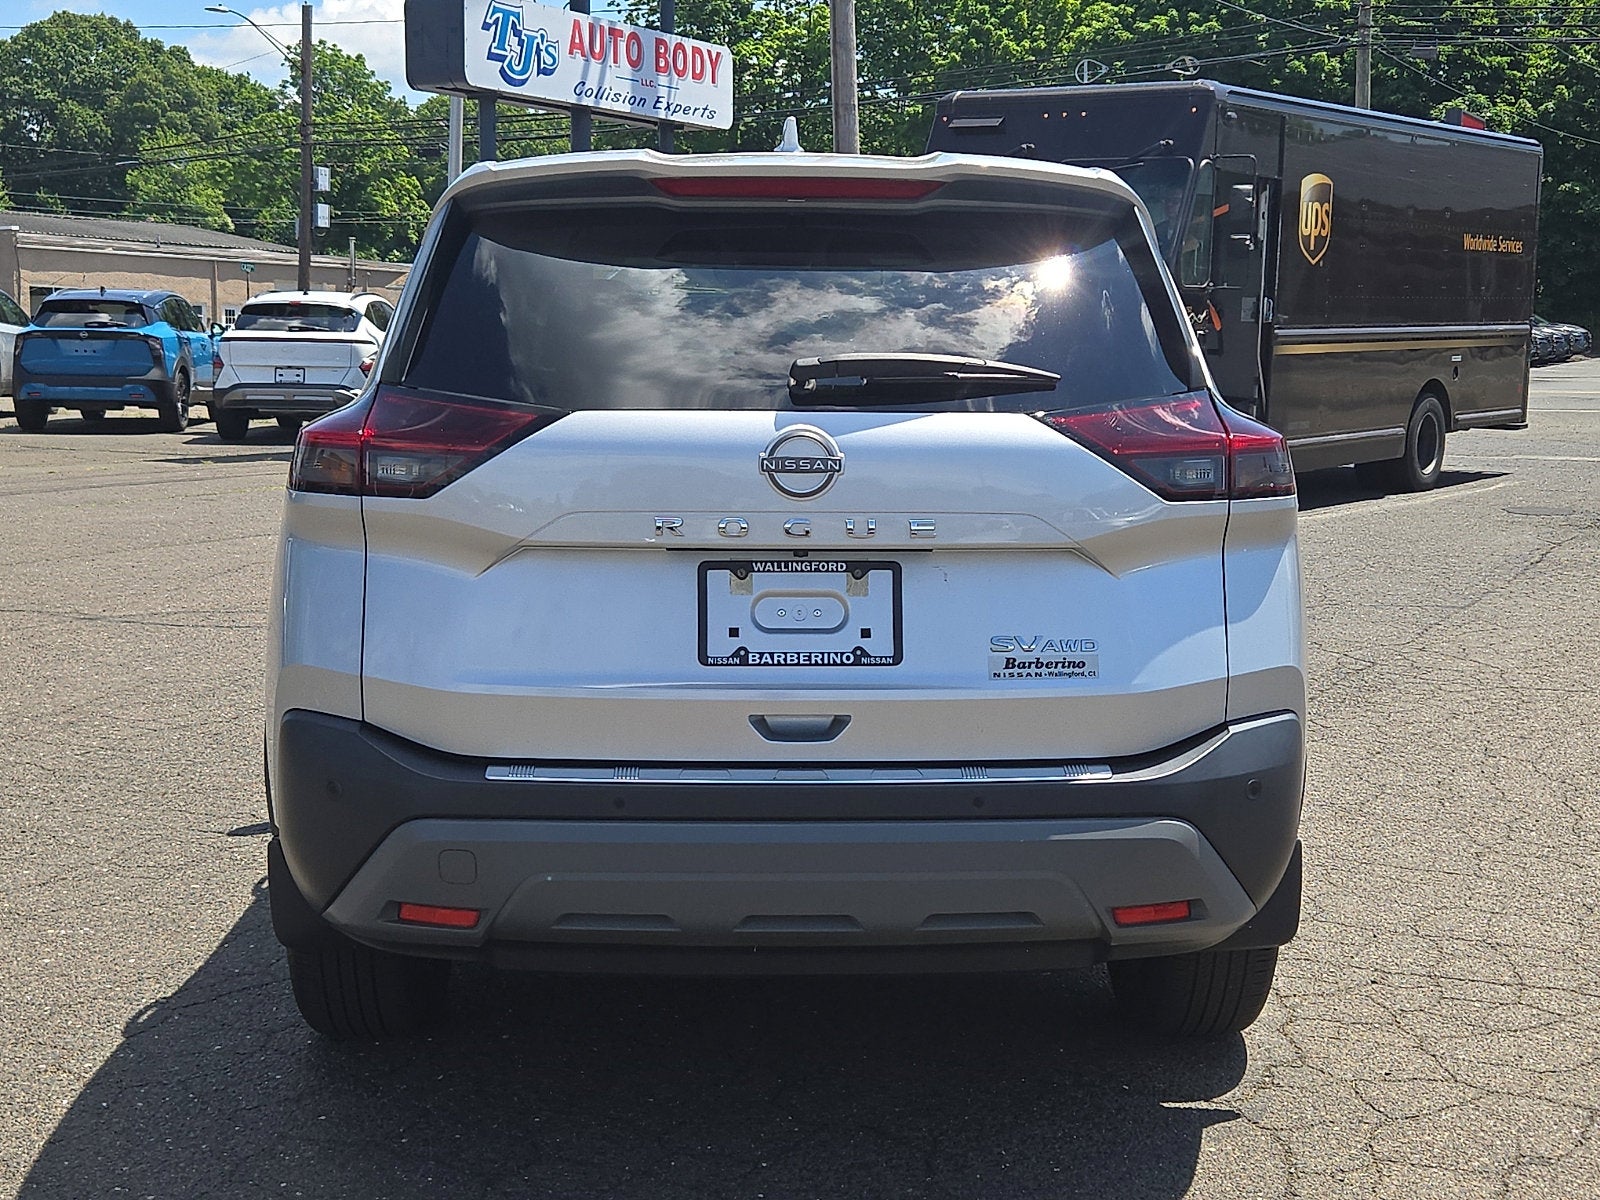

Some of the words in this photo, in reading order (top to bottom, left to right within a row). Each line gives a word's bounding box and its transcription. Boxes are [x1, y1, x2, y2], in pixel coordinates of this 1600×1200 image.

[482, 0, 560, 87] TJ's
[568, 18, 643, 71] AUTO
[654, 37, 722, 85] BODY
[640, 78, 657, 89] LLC.
[573, 80, 647, 108] Collision
[652, 95, 717, 120] Experts
[1302, 202, 1330, 250] ups
[1463, 233, 1497, 252] Worldwide
[1498, 235, 1523, 253] Services
[763, 459, 840, 471] NISSAN
[654, 516, 937, 539] ROGUE
[752, 561, 847, 572] WALLINGFORD
[989, 635, 1043, 653] SV
[1041, 639, 1099, 653] AWD
[707, 657, 740, 665] NISSAN
[748, 652, 855, 665] BARBERINO
[861, 656, 893, 665] NISSAN
[1003, 657, 1086, 670] Barberino
